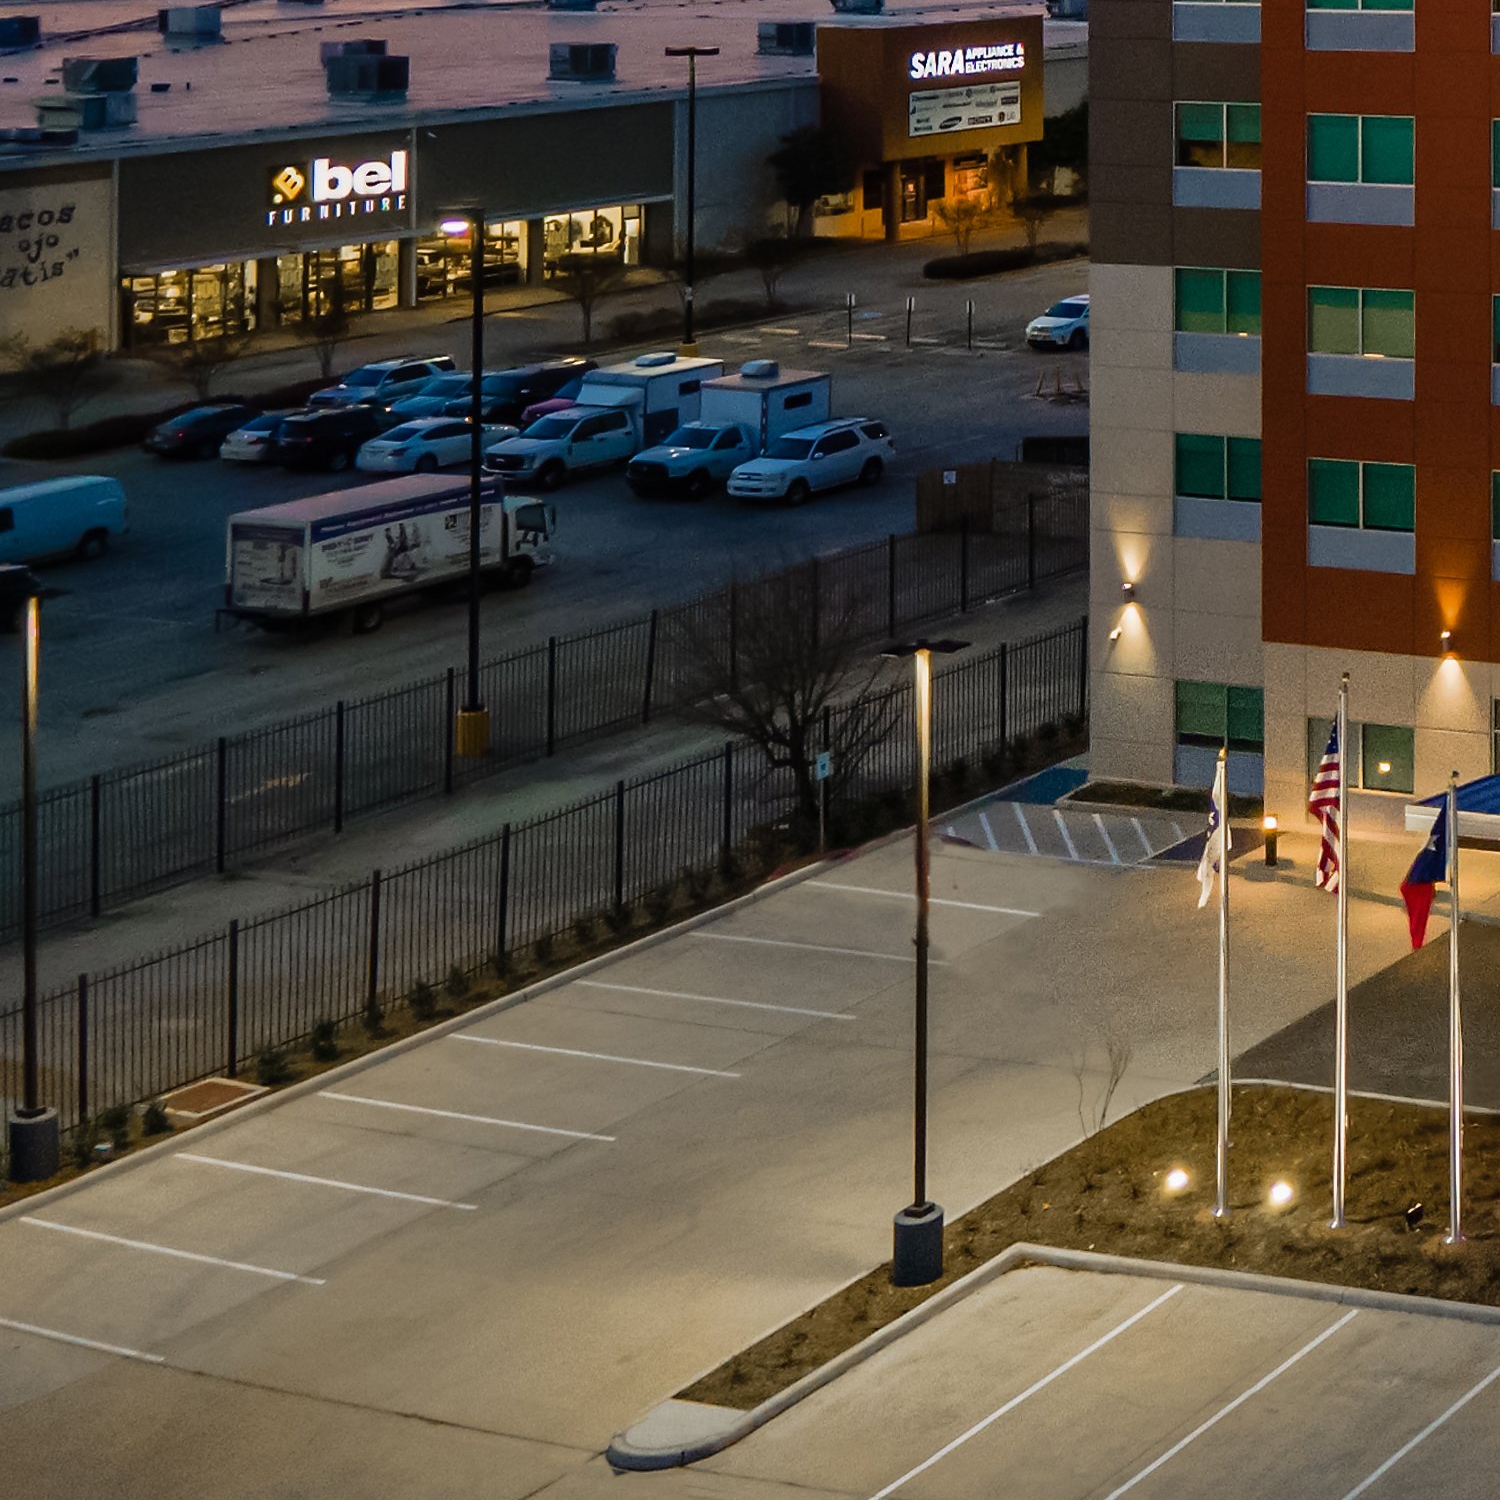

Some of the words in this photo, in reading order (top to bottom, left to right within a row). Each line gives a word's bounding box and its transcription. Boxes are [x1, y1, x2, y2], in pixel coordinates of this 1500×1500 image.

[909, 49, 965, 79] SARA
[965, 43, 1015, 61] APPLIANCE
[965, 56, 1026, 74] ELECTRONICS
[312, 150, 408, 202] bel
[266, 194, 407, 227] FURNITURE
[17, 232, 60, 264] ojo
